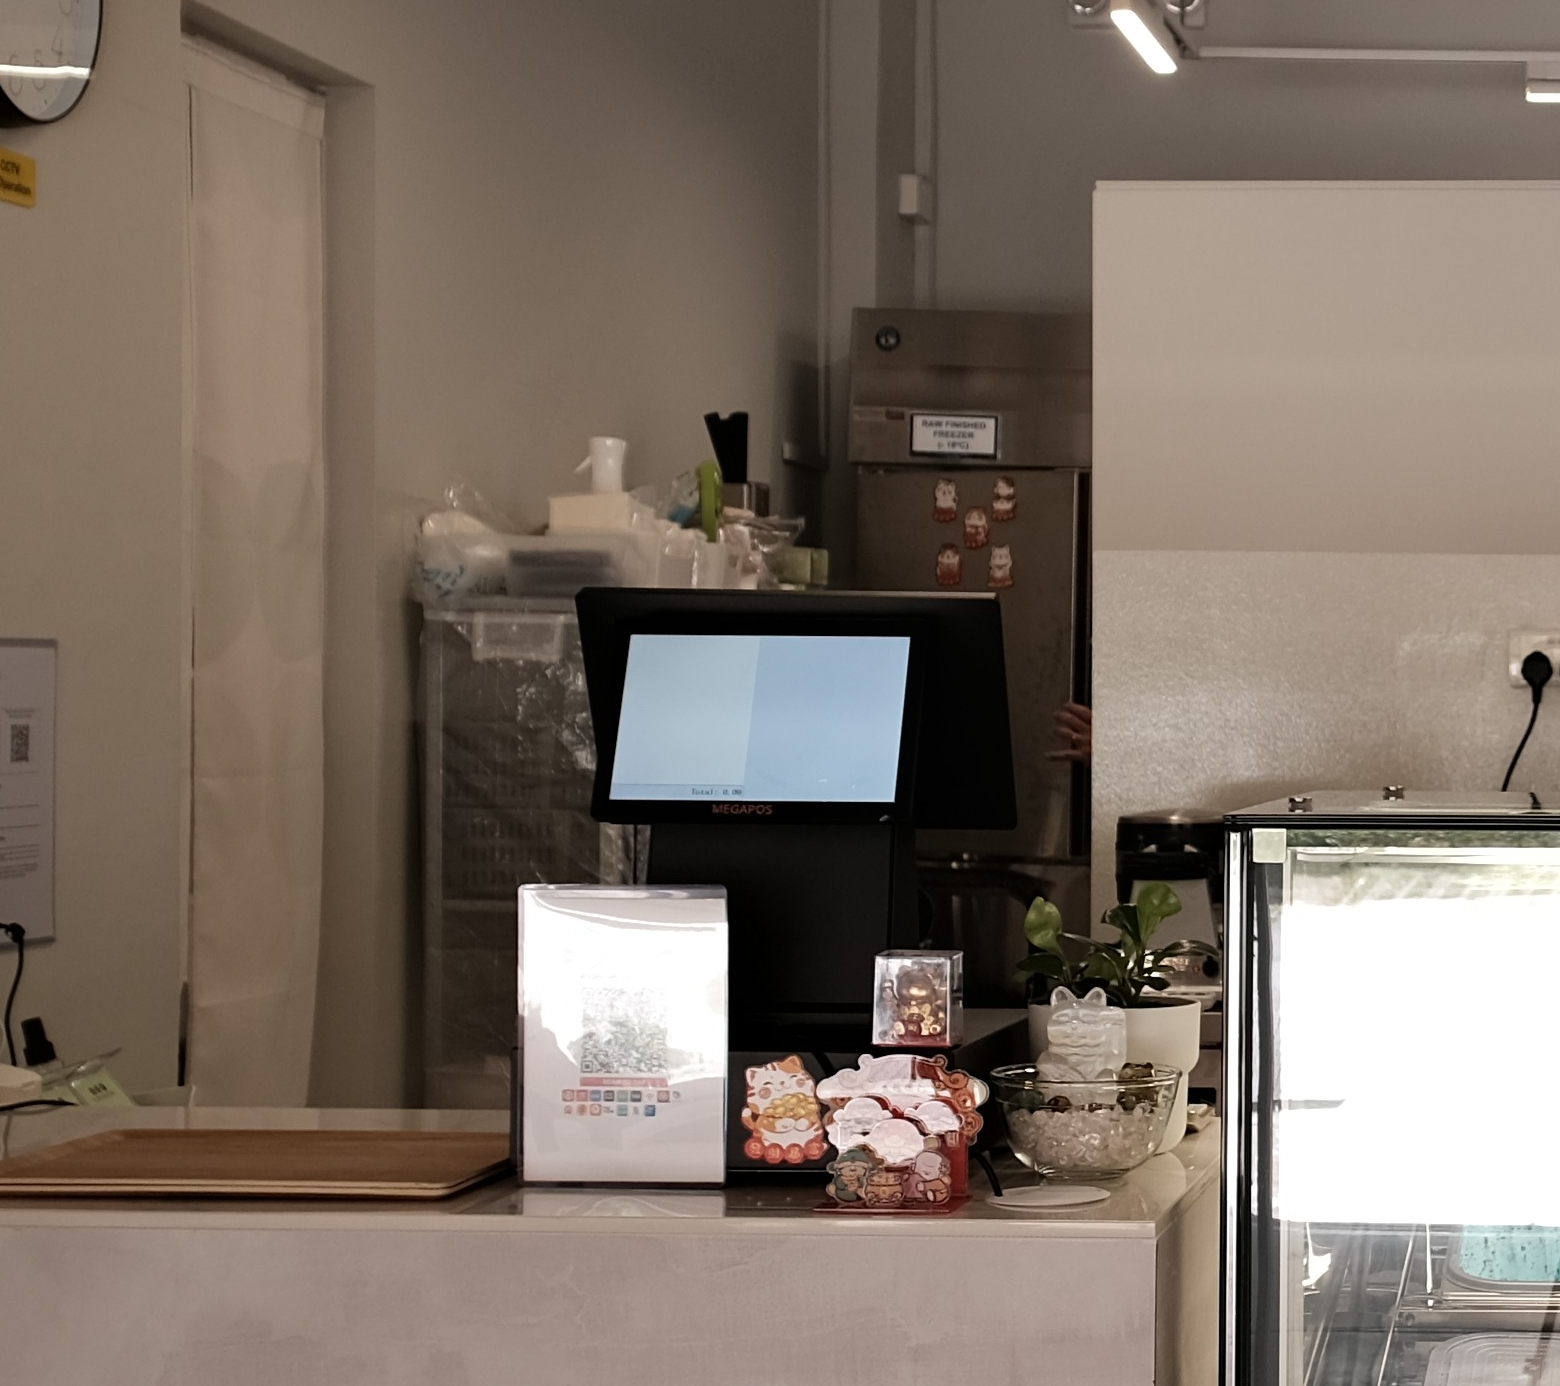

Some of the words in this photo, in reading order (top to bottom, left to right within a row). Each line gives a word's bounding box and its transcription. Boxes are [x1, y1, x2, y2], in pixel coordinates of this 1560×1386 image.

[0, 158, 21, 176] CCTV
[921, 419, 943, 428] RAW
[933, 431, 975, 440] FREEZER
[711, 804, 774, 815] MEGAPOS
